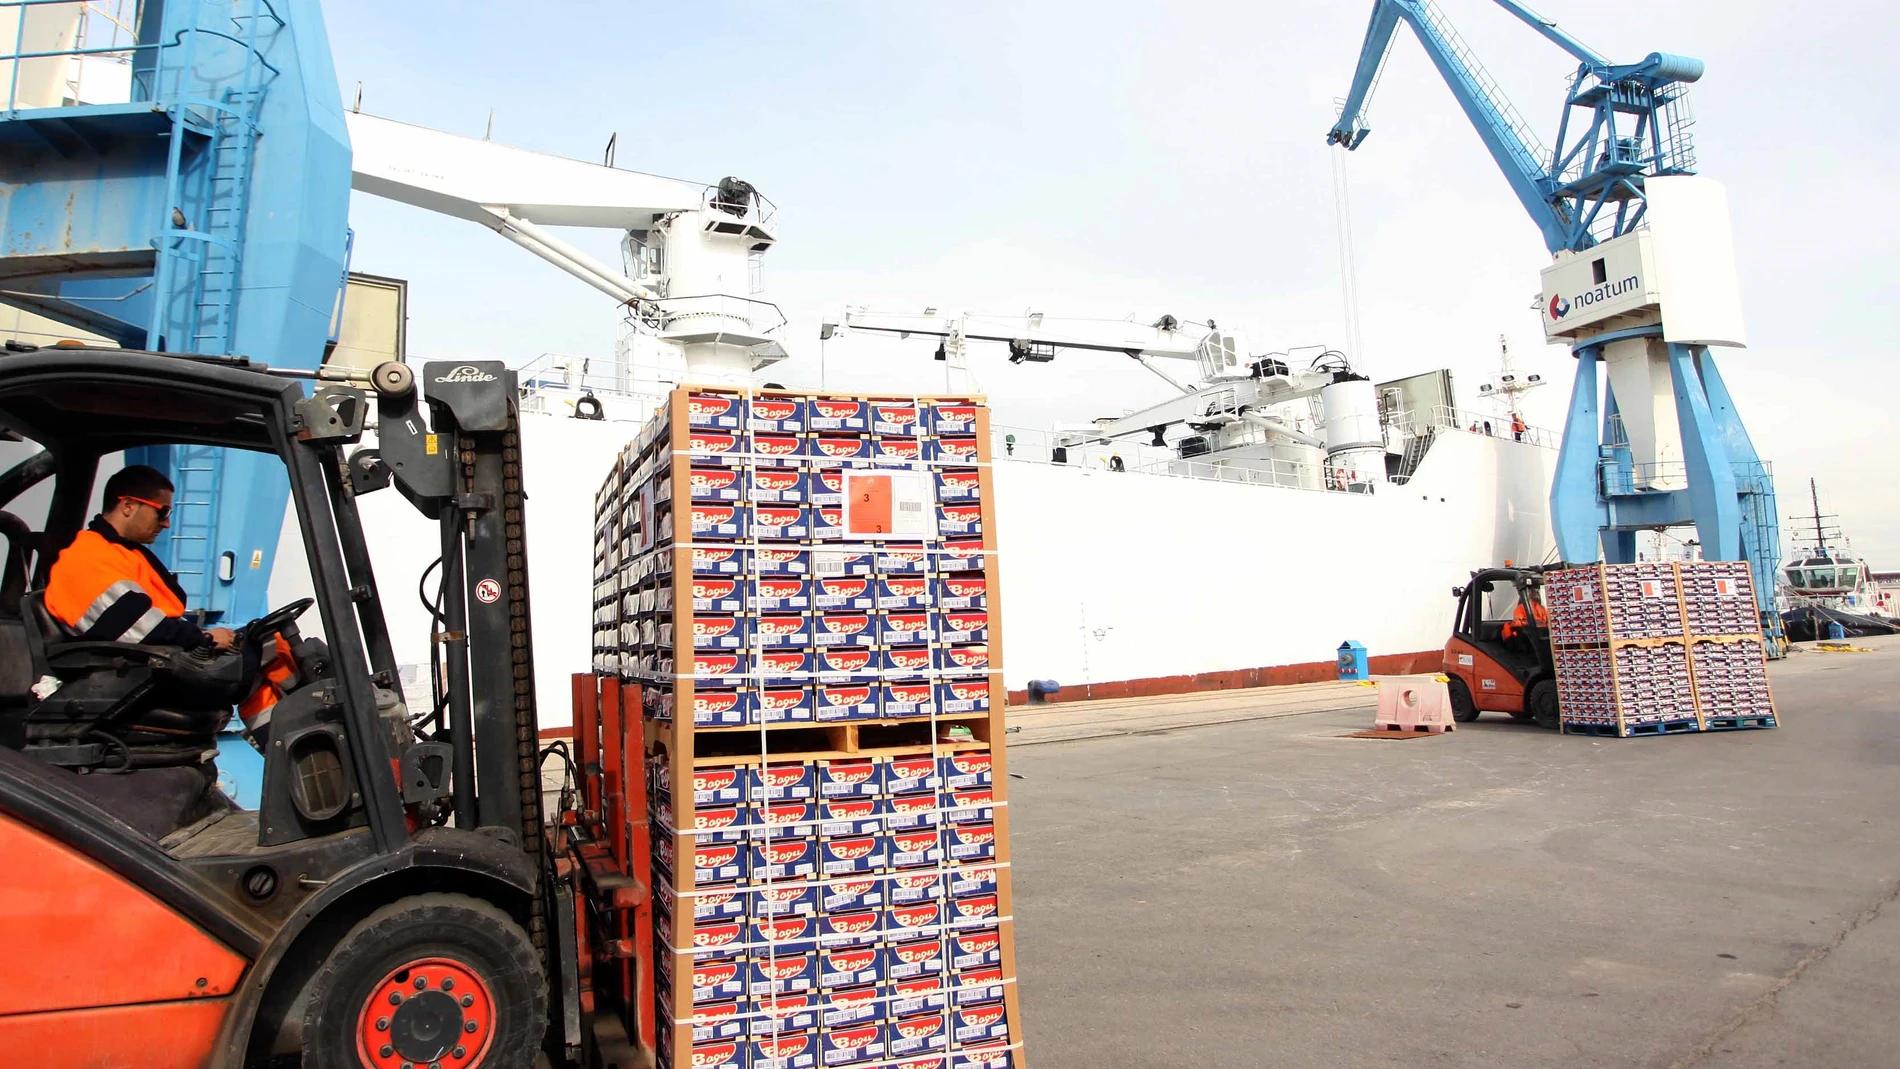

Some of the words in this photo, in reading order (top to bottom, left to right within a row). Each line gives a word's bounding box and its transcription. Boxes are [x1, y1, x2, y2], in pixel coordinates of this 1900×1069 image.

[1575, 276, 1638, 309] noatum
[435, 365, 497, 383] Linde
[754, 407, 790, 419] Bagu
[819, 407, 854, 419] Bagu
[941, 411, 974, 422] Bagu
[755, 442, 793, 455] Bagu
[821, 444, 856, 456] Bagu
[882, 446, 918, 457] Bagu
[943, 444, 976, 455] Bagu
[757, 477, 794, 490] Bagu
[944, 478, 978, 489] Bagu
[863, 493, 870, 502] 3
[757, 514, 795, 527] Bagu
[945, 511, 980, 522] Bagu
[876, 525, 882, 533] 3
[759, 586, 798, 599] Bagu
[825, 586, 863, 597] Bagu
[889, 585, 925, 597] Bagu
[950, 585, 984, 597] Bagu
[760, 623, 798, 635] Bagu
[826, 622, 863, 633] Bagu
[890, 620, 925, 632] Bagu
[950, 619, 984, 631] Bagu
[827, 657, 865, 670] Bagu
[892, 654, 928, 669] Bagu
[952, 653, 986, 667] Bagu
[827, 693, 865, 706] Bagu
[892, 690, 929, 703] Bagu
[954, 688, 988, 700] Bagu
[764, 696, 798, 709] Bagu
[894, 765, 932, 779] Bagu
[955, 760, 990, 774] Bagu
[830, 771, 868, 783] Bagu
[959, 831, 994, 845] Bagu
[833, 845, 870, 859] Bagu
[897, 839, 934, 852] Bagu
[898, 877, 934, 890] Bagu
[960, 903, 994, 916] Bagu
[832, 920, 872, 933] Bagu
[896, 913, 934, 927] Bagu
[961, 940, 996, 953] Bagu
[899, 949, 936, 963] Bagu
[832, 958, 870, 972] Bagu
[963, 1013, 999, 1026] Bagu
[900, 1025, 937, 1038] Bagu
[834, 1035, 873, 1049] Bagu
